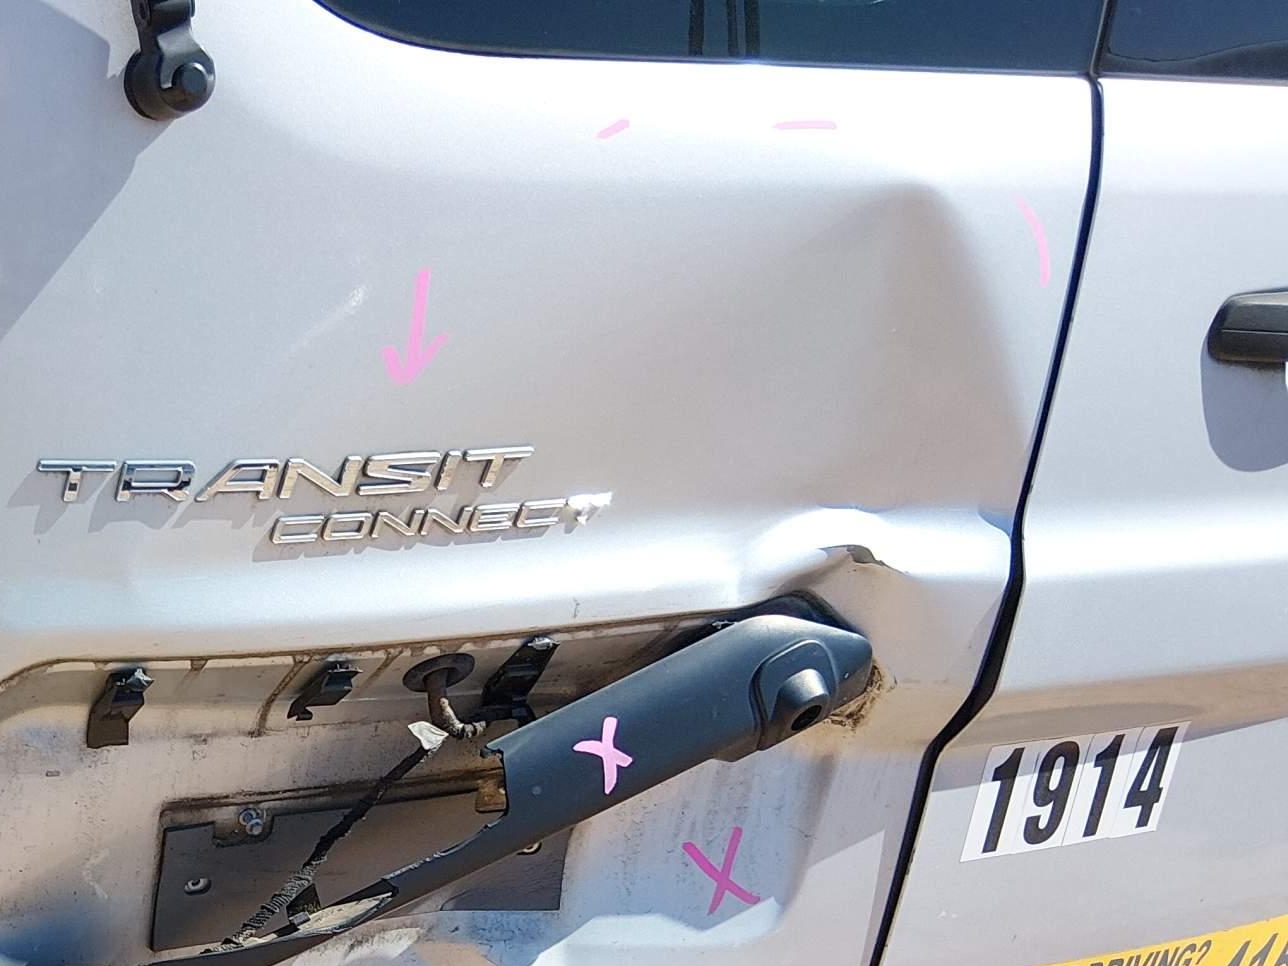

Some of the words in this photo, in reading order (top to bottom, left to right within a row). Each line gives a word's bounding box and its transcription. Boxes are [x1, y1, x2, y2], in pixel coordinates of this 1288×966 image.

[37, 445, 535, 501] TRANSIT
[271, 491, 613, 545] CONNECT
[981, 726, 1179, 854] 1914
